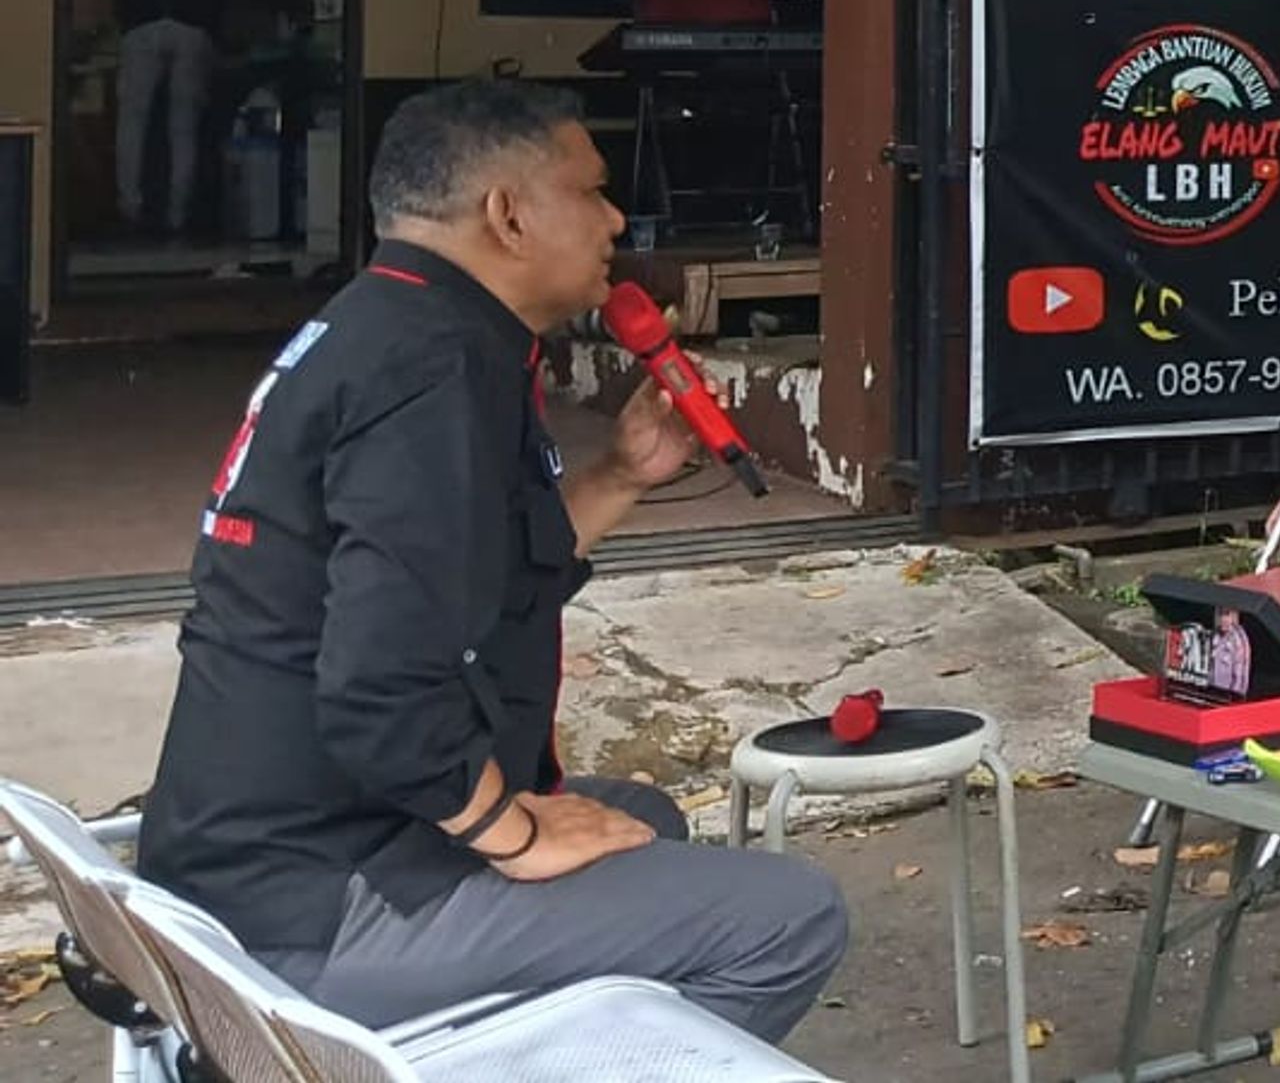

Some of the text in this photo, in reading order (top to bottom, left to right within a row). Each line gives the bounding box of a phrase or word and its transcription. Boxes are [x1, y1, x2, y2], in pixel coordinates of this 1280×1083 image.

[1101, 45, 1164, 111] LEMBAGA
[1160, 35, 1236, 67] BANTUAN
[1079, 120, 1184, 160] ELANG
[1146, 163, 1232, 202] LBH
[1066, 366, 1144, 403] WA.
